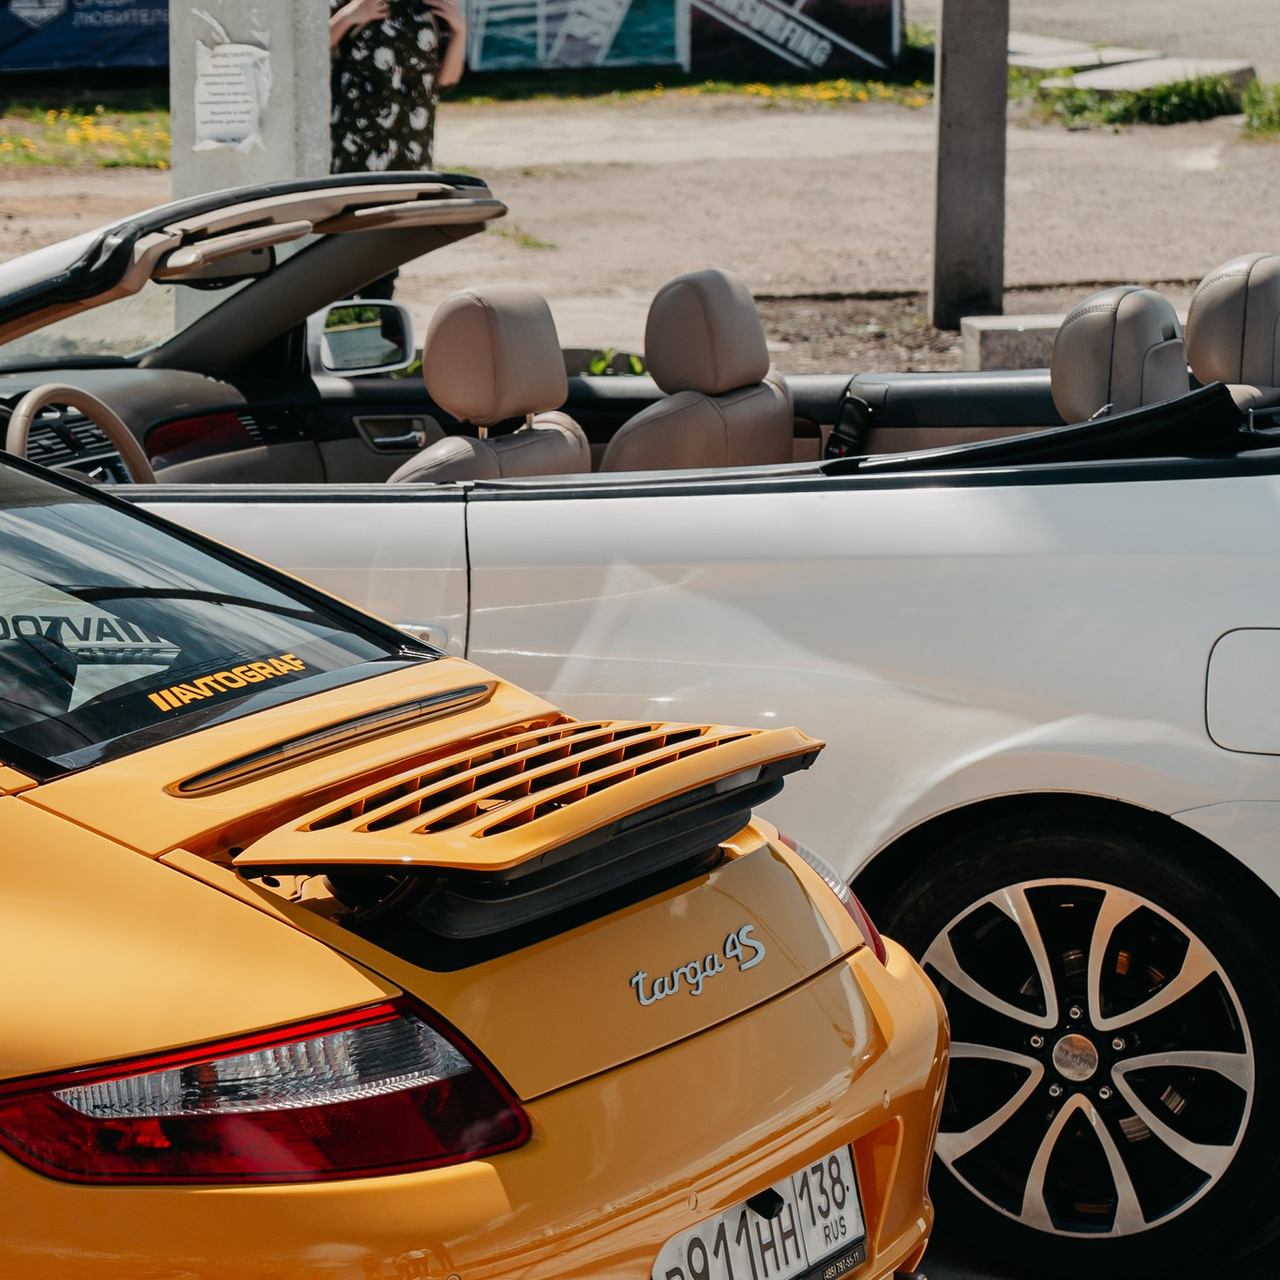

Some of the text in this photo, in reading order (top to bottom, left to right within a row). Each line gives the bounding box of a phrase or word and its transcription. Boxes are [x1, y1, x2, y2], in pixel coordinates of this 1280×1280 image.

[724, 923, 767, 972] 4S
[798, 1155, 847, 1227] 138
[823, 1215, 847, 1247] RUS
